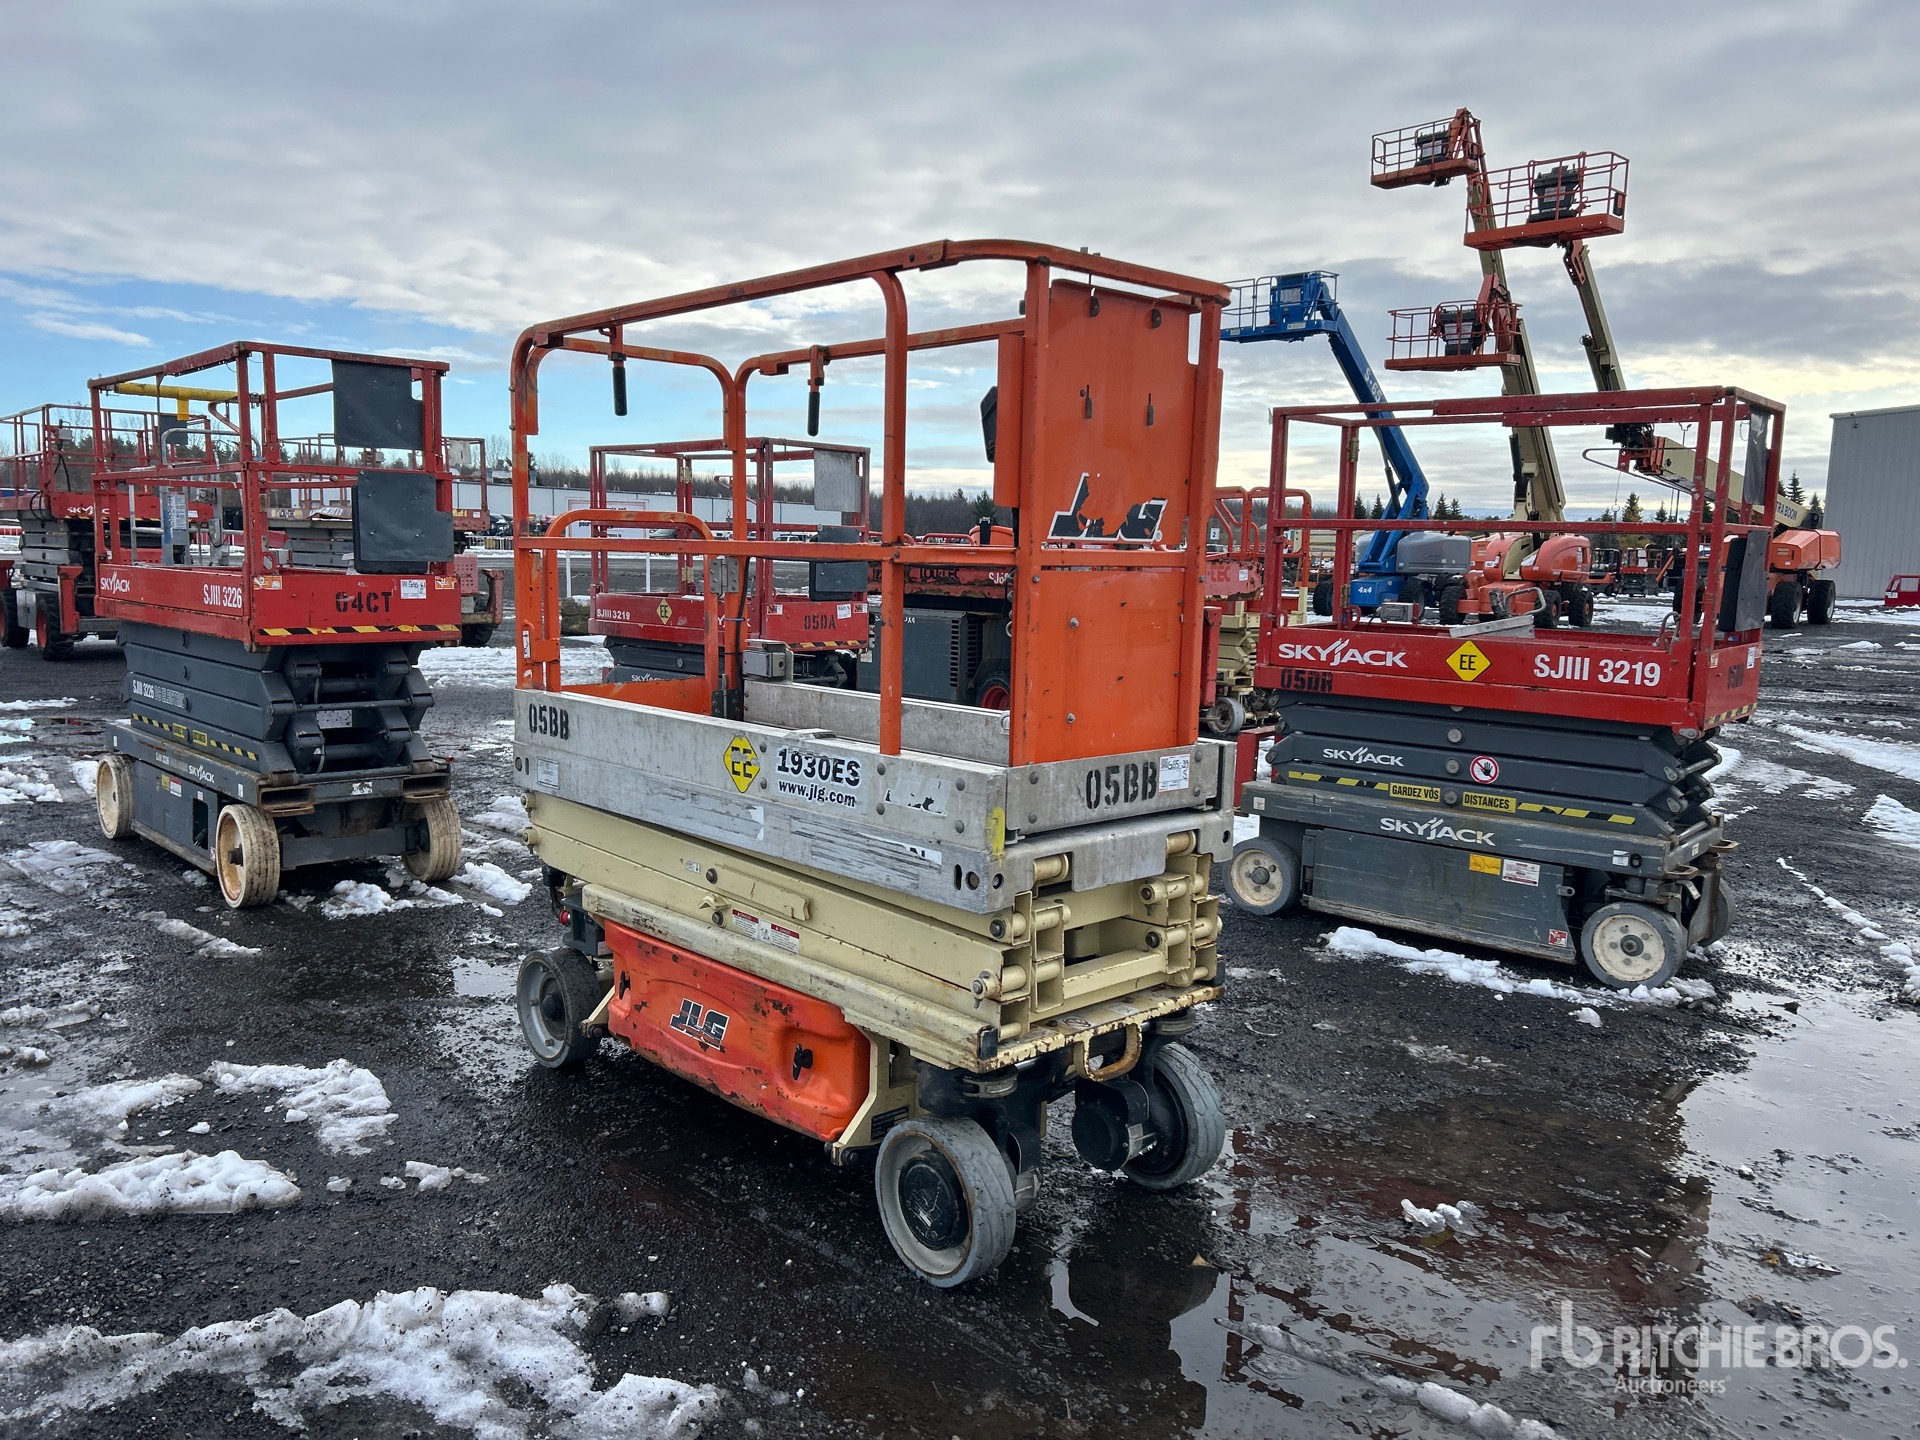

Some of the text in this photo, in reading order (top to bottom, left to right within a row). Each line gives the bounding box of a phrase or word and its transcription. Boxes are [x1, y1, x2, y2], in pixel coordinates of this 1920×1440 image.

[100, 571, 130, 594] SKYJACK
[222, 586, 242, 609] 3226
[335, 591, 392, 613] 04CT
[612, 611, 631, 621] 3219
[659, 604, 669, 619] EE
[803, 614, 837, 630] 05DA
[1278, 637, 1409, 669] SKYJACK
[1459, 654, 1477, 671] EE
[1597, 658, 1662, 687] 3219
[528, 702, 570, 741] 05BB
[777, 748, 862, 787] 1930ES
[1322, 746, 1405, 767] SKYJACK
[188, 764, 215, 784] SKYJACK
[1085, 761, 1158, 810] 05BB
[778, 779, 857, 808] www.jlg.com
[1392, 785, 1422, 798] GARDEZ
[1464, 794, 1510, 810] DISTANCES
[1380, 816, 1497, 847] SKYJACK
